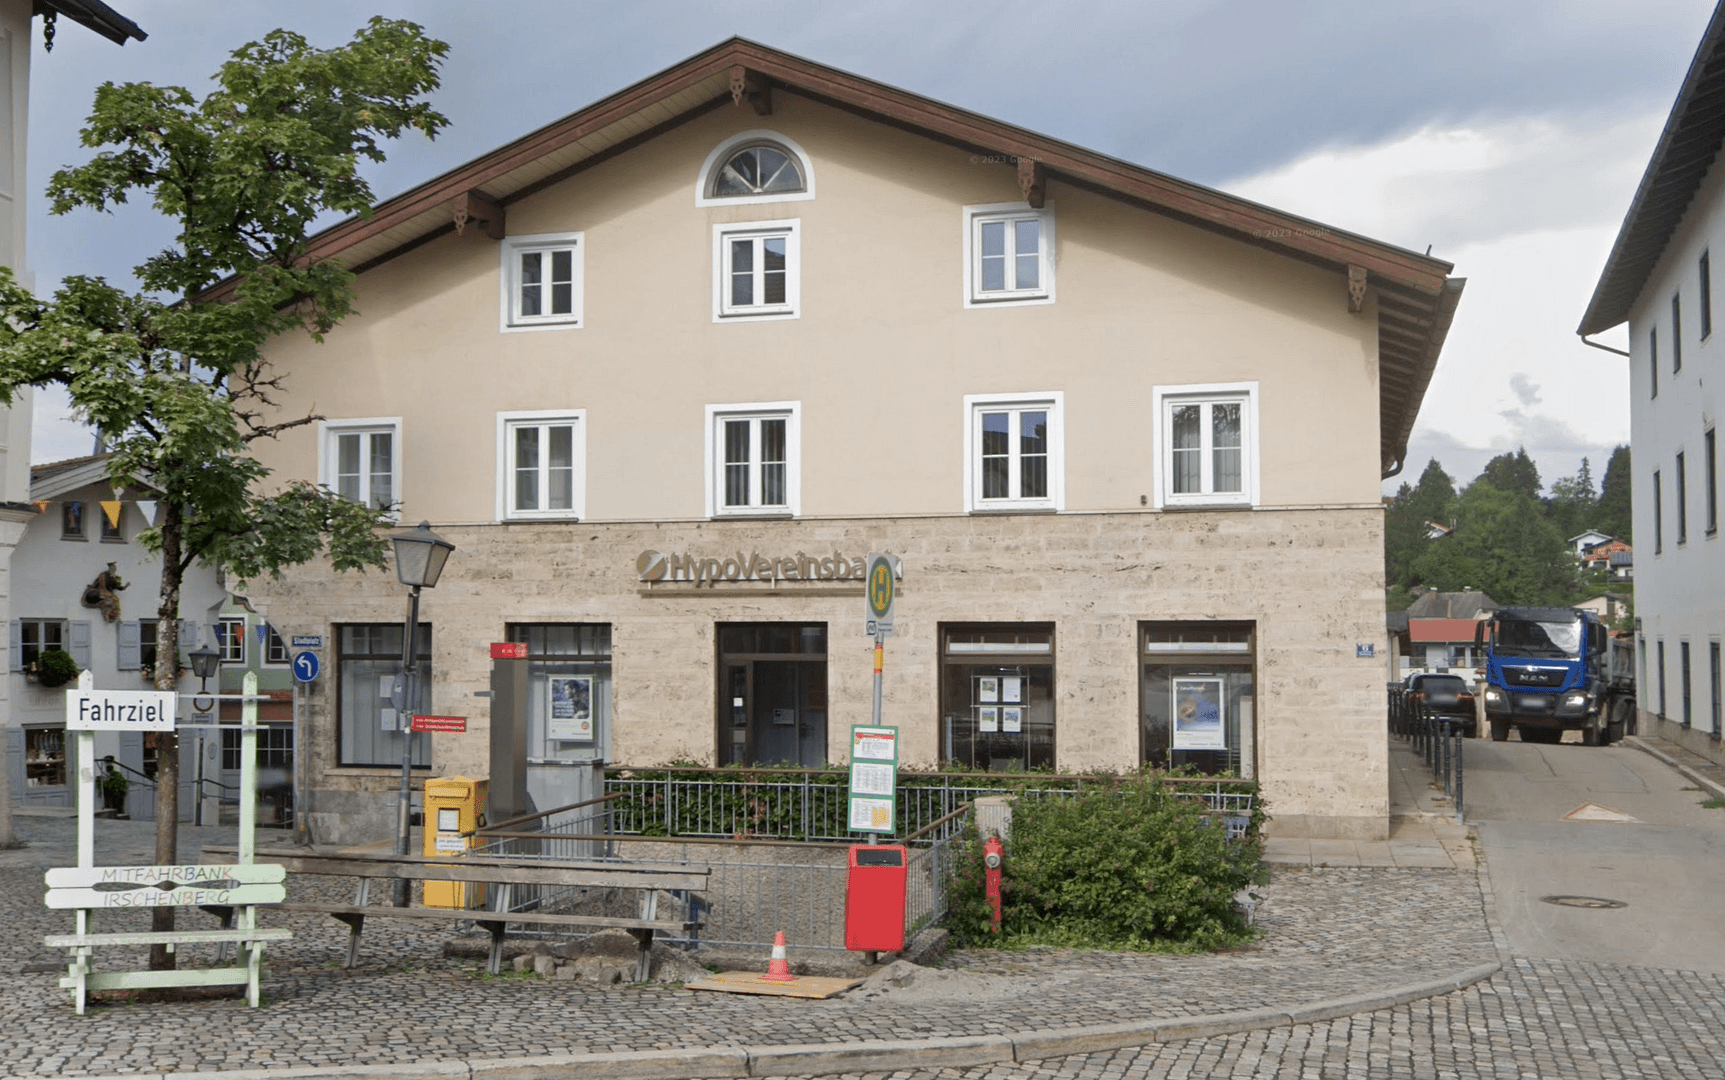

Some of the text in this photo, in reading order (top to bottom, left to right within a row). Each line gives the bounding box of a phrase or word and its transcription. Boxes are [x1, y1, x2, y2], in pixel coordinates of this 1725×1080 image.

[670, 550, 868, 588] HypoVereinsba
[79, 697, 165, 722] Fahrziel
[101, 866, 233, 881] MITFAHRBANK
[103, 889, 230, 907] IRSCHENBERG
